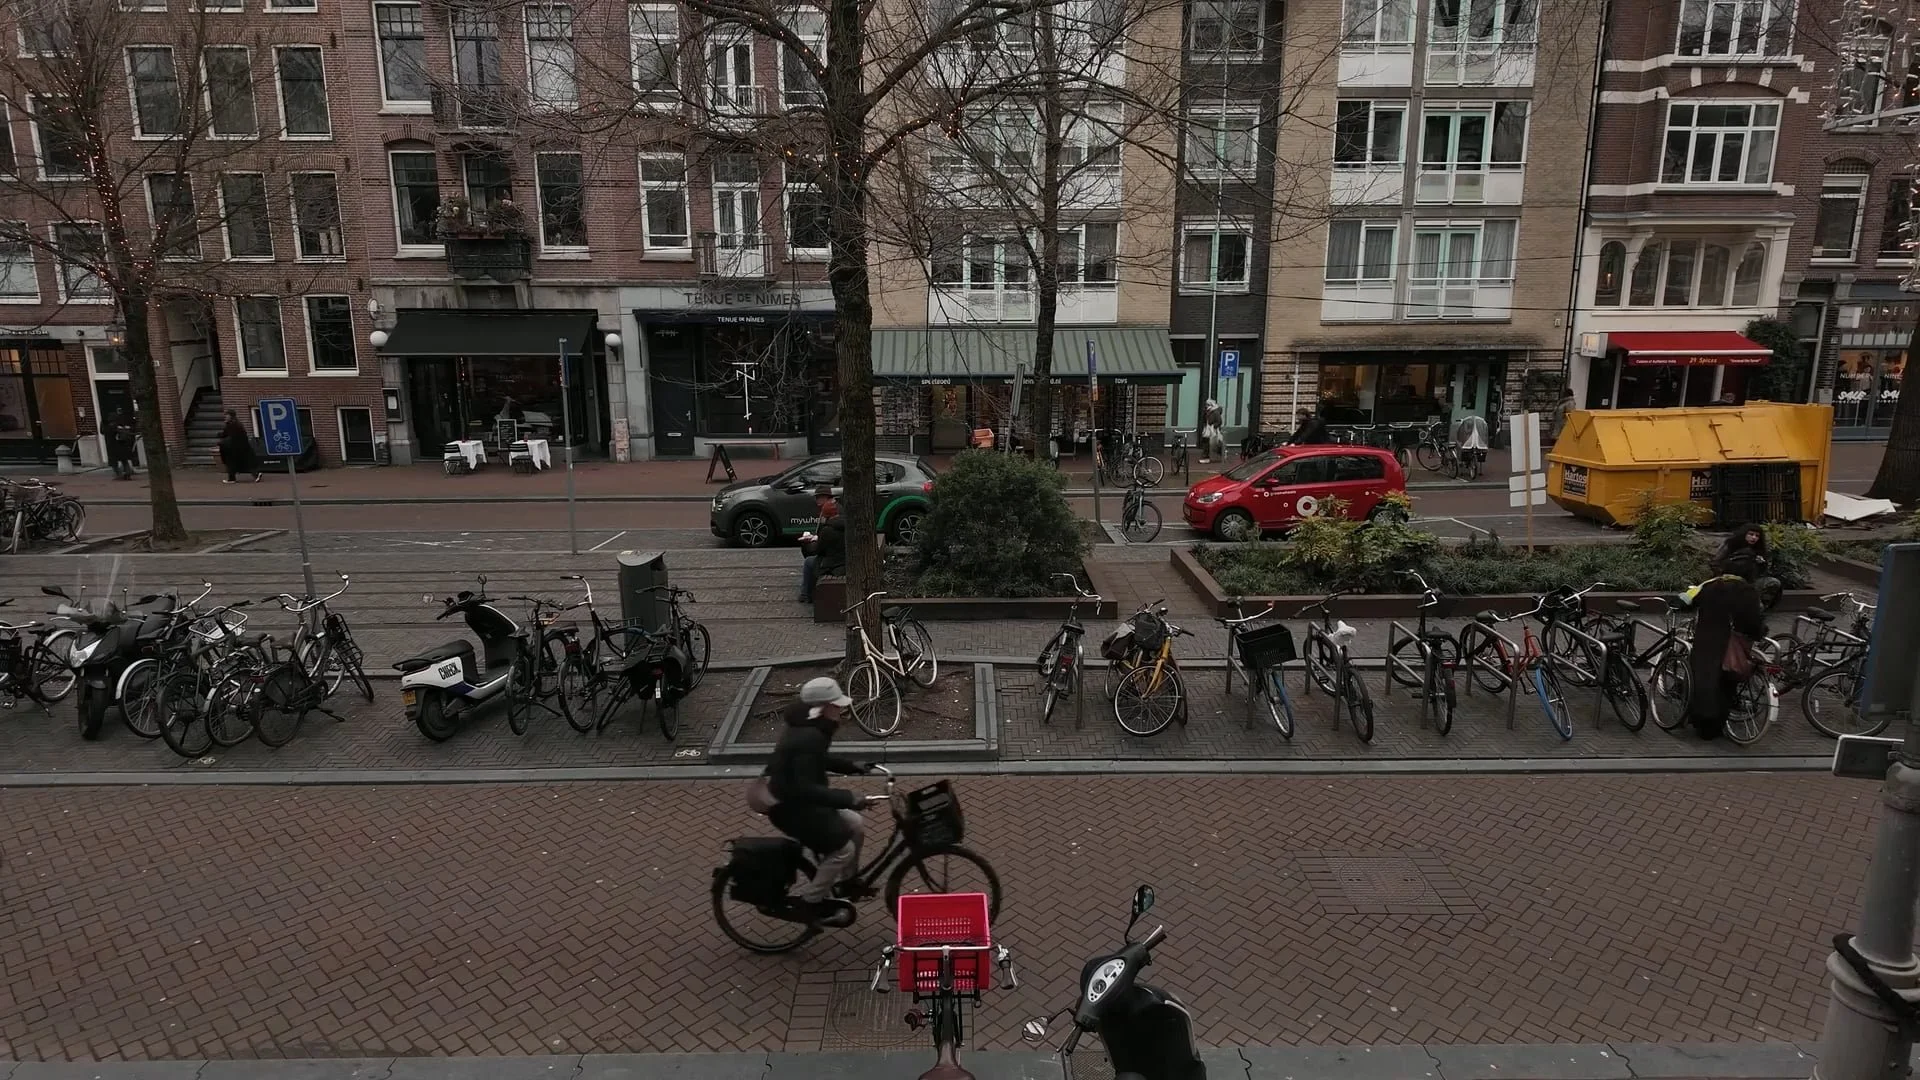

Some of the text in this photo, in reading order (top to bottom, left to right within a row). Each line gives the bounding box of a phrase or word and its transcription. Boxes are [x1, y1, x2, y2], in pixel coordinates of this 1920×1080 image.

[684, 293, 732, 304] TENUE
[1859, 306, 1911, 316] UMBER
[1225, 353, 1235, 366] P
[1699, 356, 1718, 365] Spices
[1838, 391, 1866, 400] SALE
[267, 403, 288, 430] P
[1692, 476, 1713, 485] Har
